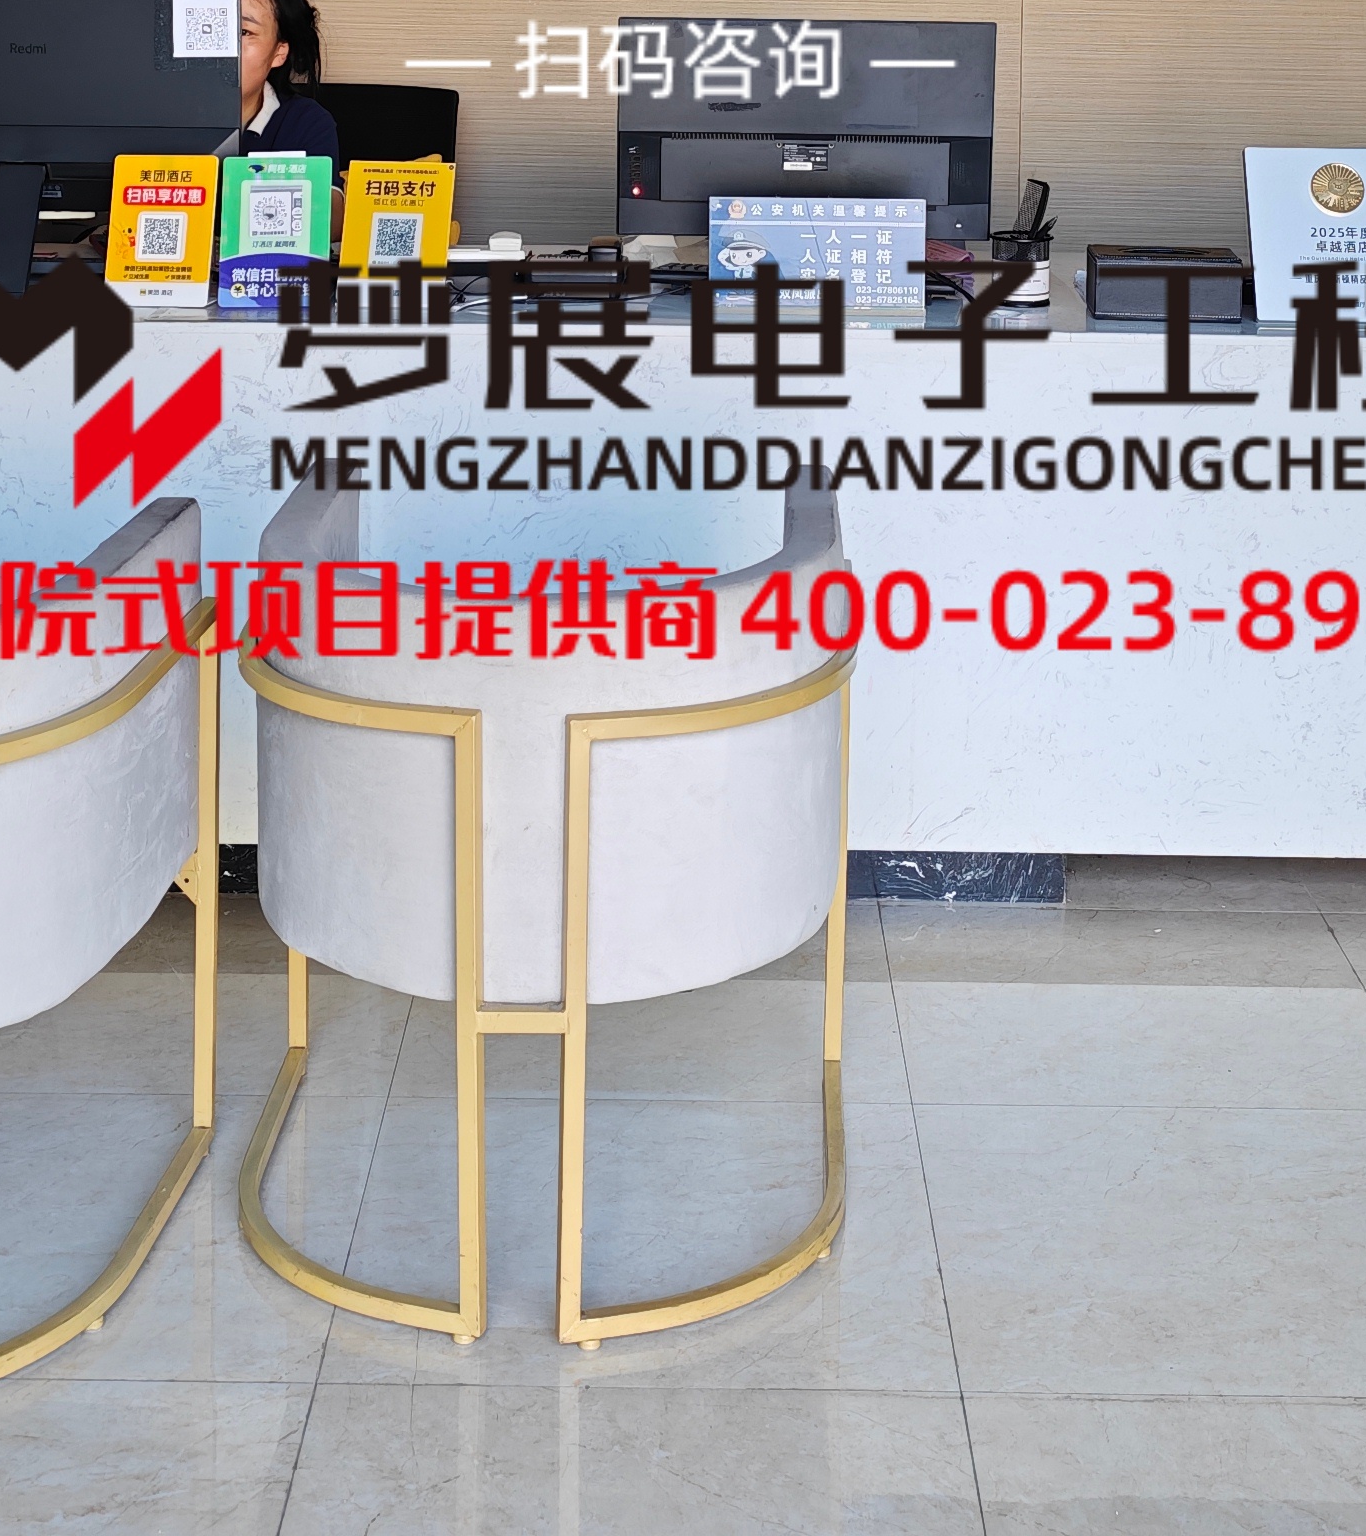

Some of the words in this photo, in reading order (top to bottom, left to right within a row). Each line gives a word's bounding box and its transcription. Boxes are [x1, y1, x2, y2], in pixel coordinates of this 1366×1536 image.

[10, 43, 46, 54] Redmi
[140, 170, 193, 183] 美团酒店
[126, 188, 203, 204] 扫码享优惠
[365, 180, 436, 197] 扫码支付
[751, 204, 908, 218] 公安机关温馨提示
[800, 230, 893, 245] 一人一证
[800, 249, 893, 264] 人证相符
[800, 268, 892, 284] 实名登记
[856, 286, 919, 295] 023-67806110
